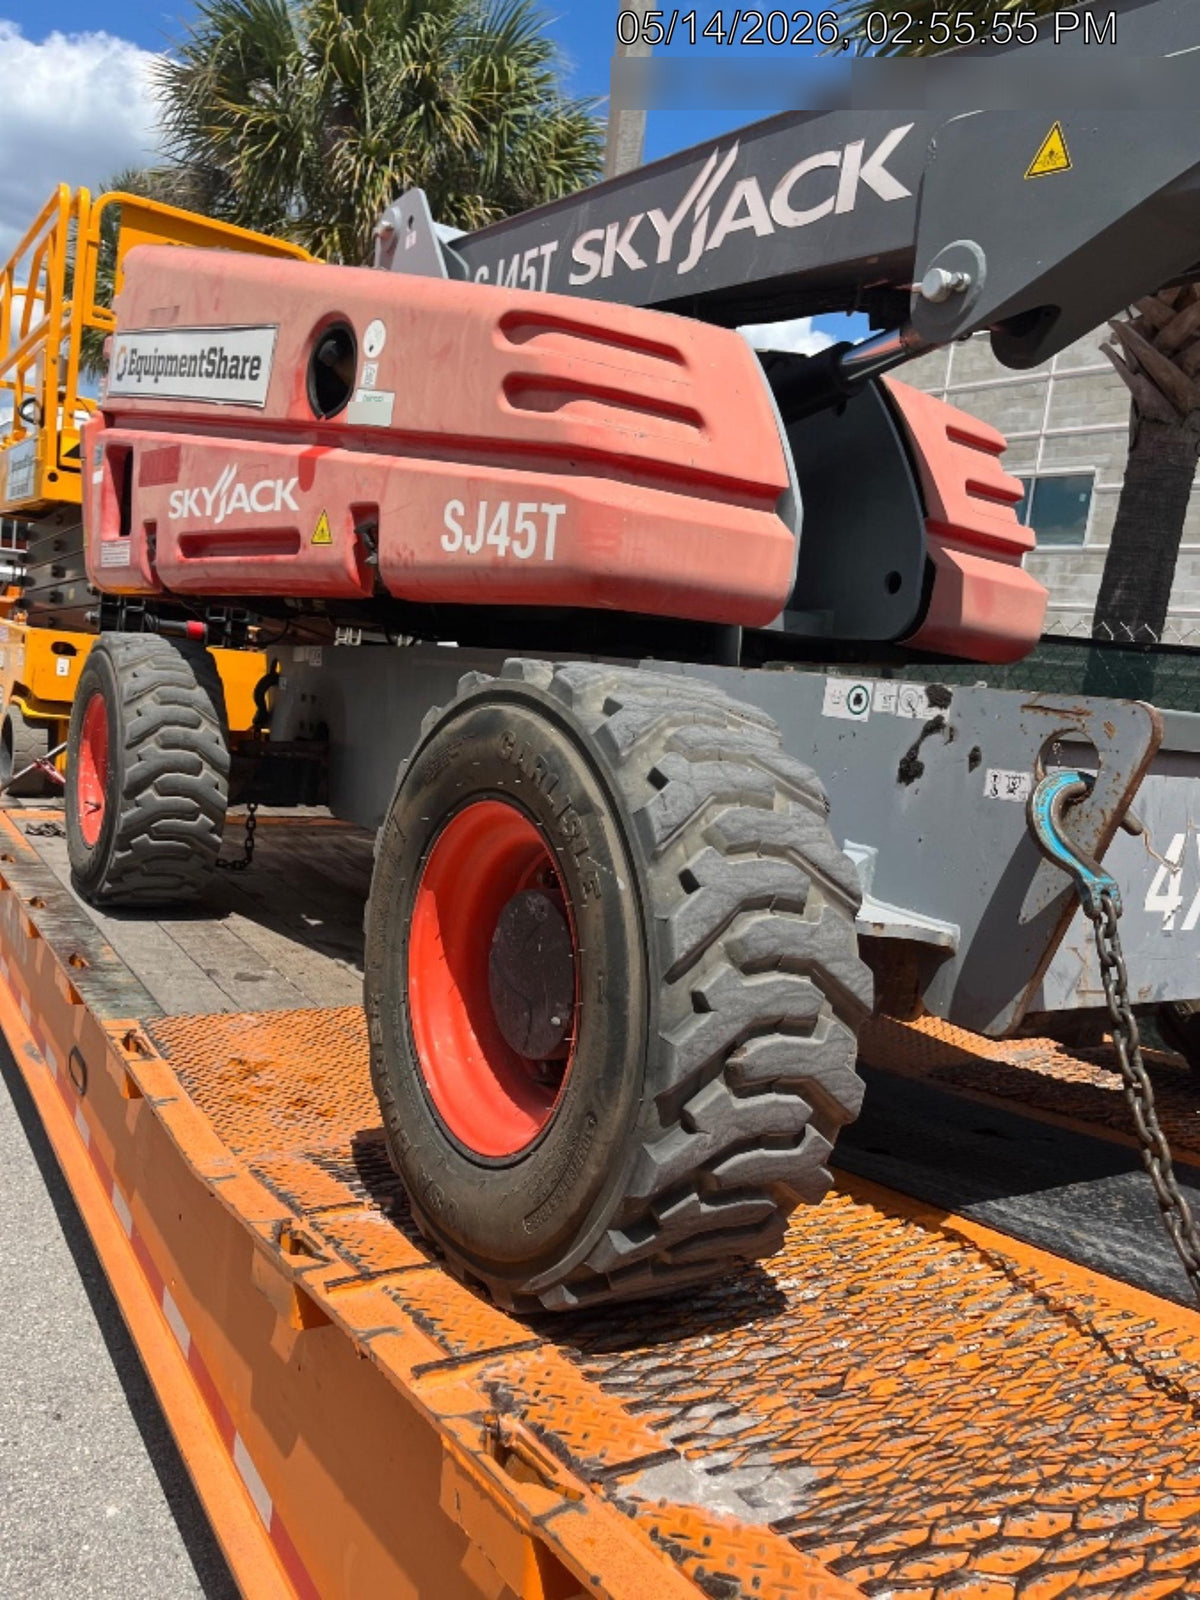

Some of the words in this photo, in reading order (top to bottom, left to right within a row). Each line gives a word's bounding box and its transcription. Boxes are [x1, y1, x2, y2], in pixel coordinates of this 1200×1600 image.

[568, 122, 915, 286] SKYJACK
[128, 346, 262, 384] EquipmentShare
[168, 463, 300, 525] SKYJACK
[440, 499, 567, 561] SJ45T
[500, 729, 603, 902] CARLISLE
